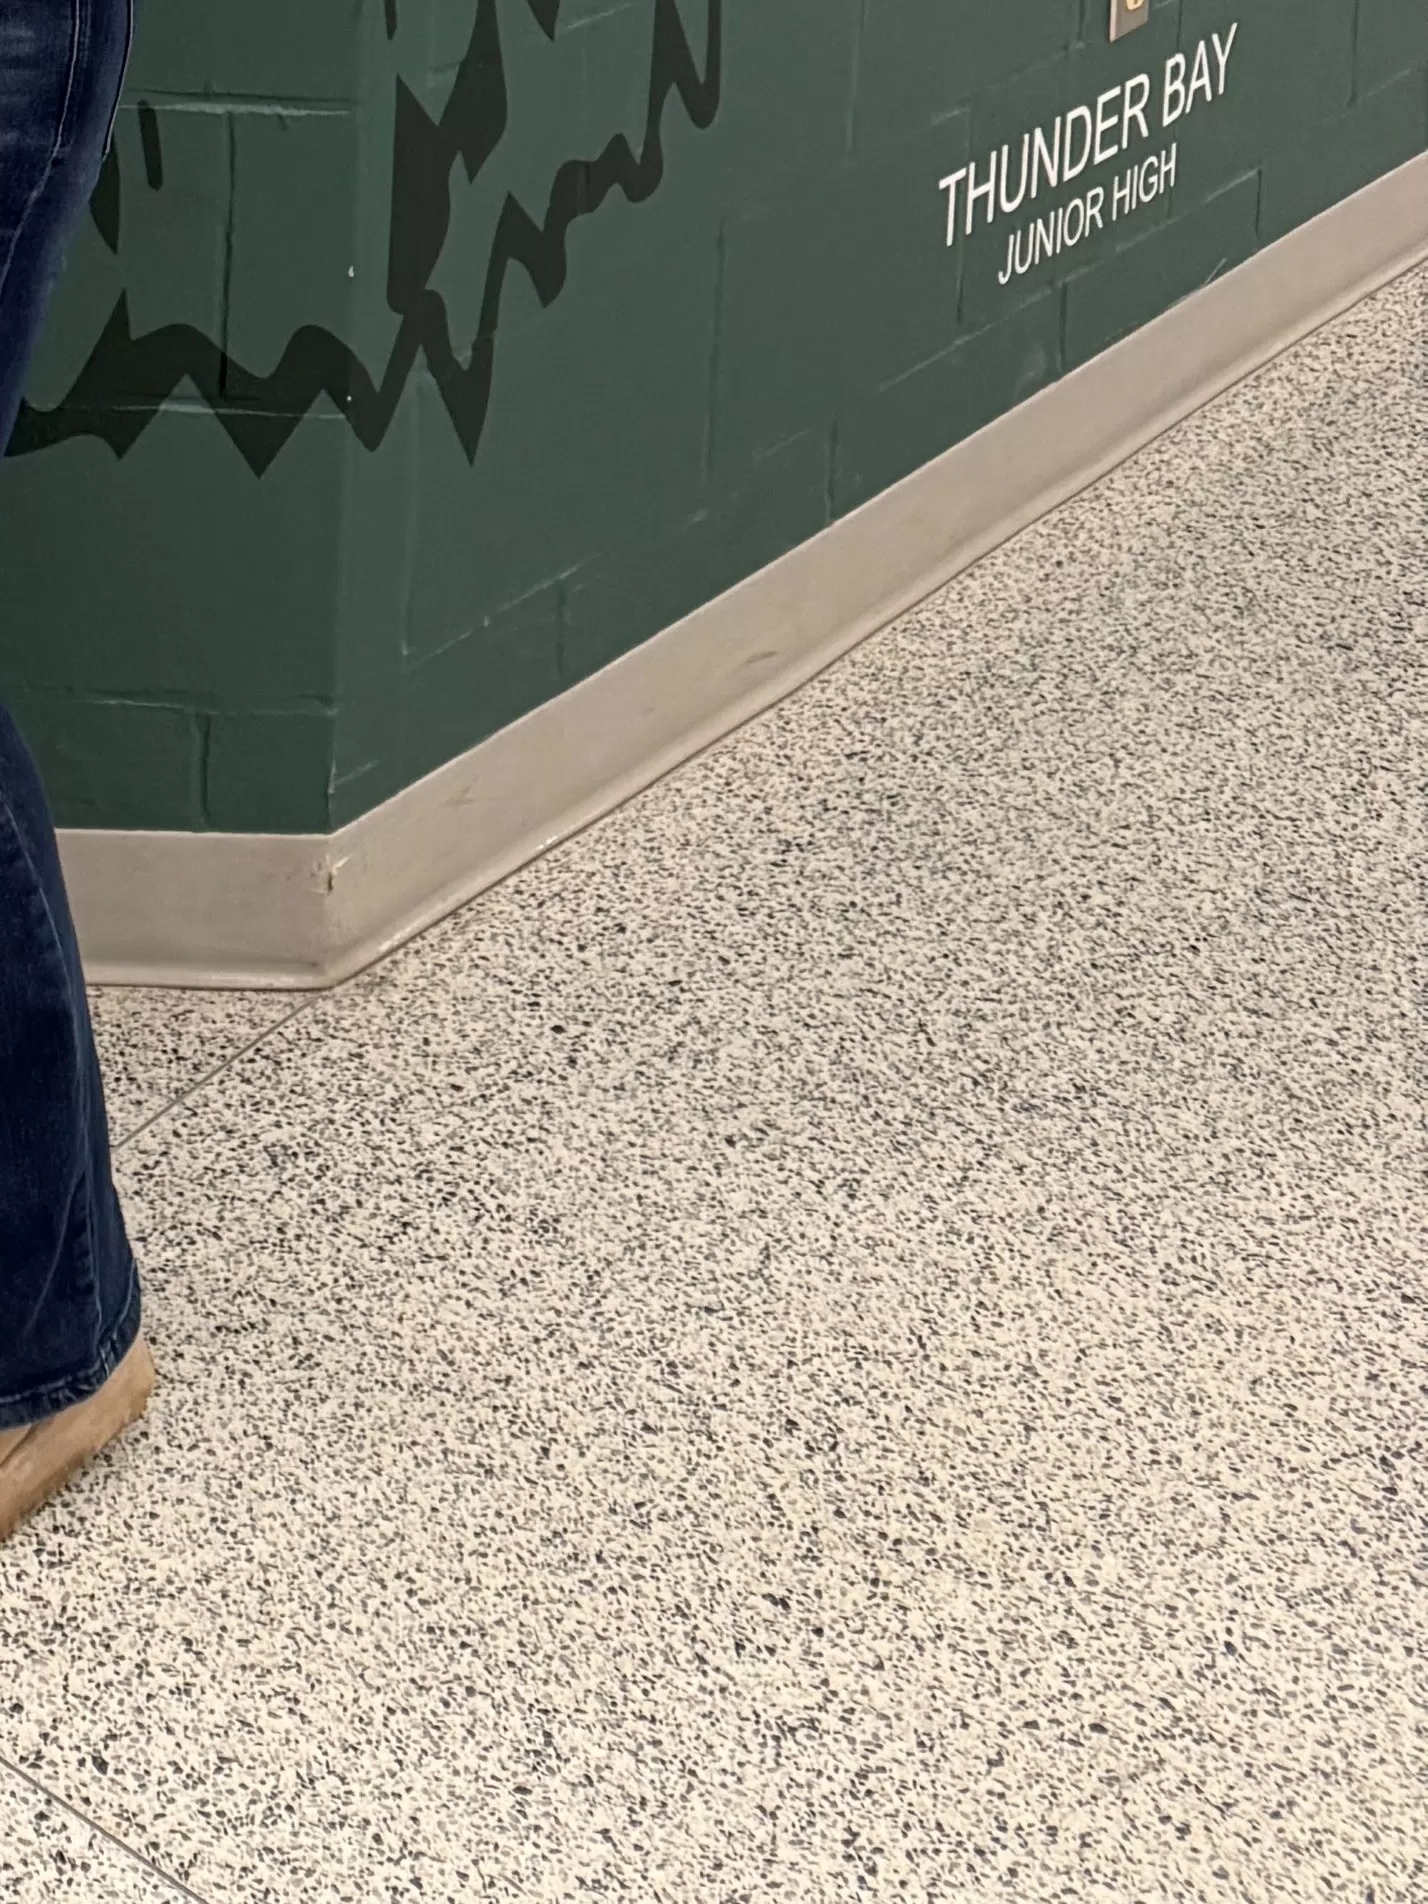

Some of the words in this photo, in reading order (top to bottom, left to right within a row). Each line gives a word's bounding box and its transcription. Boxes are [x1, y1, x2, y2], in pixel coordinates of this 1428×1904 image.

[938, 73, 1151, 248] THUNDER
[1162, 22, 1239, 128] BAY
[997, 185, 1105, 286] JUNIOR
[1112, 142, 1179, 222] HIGH
